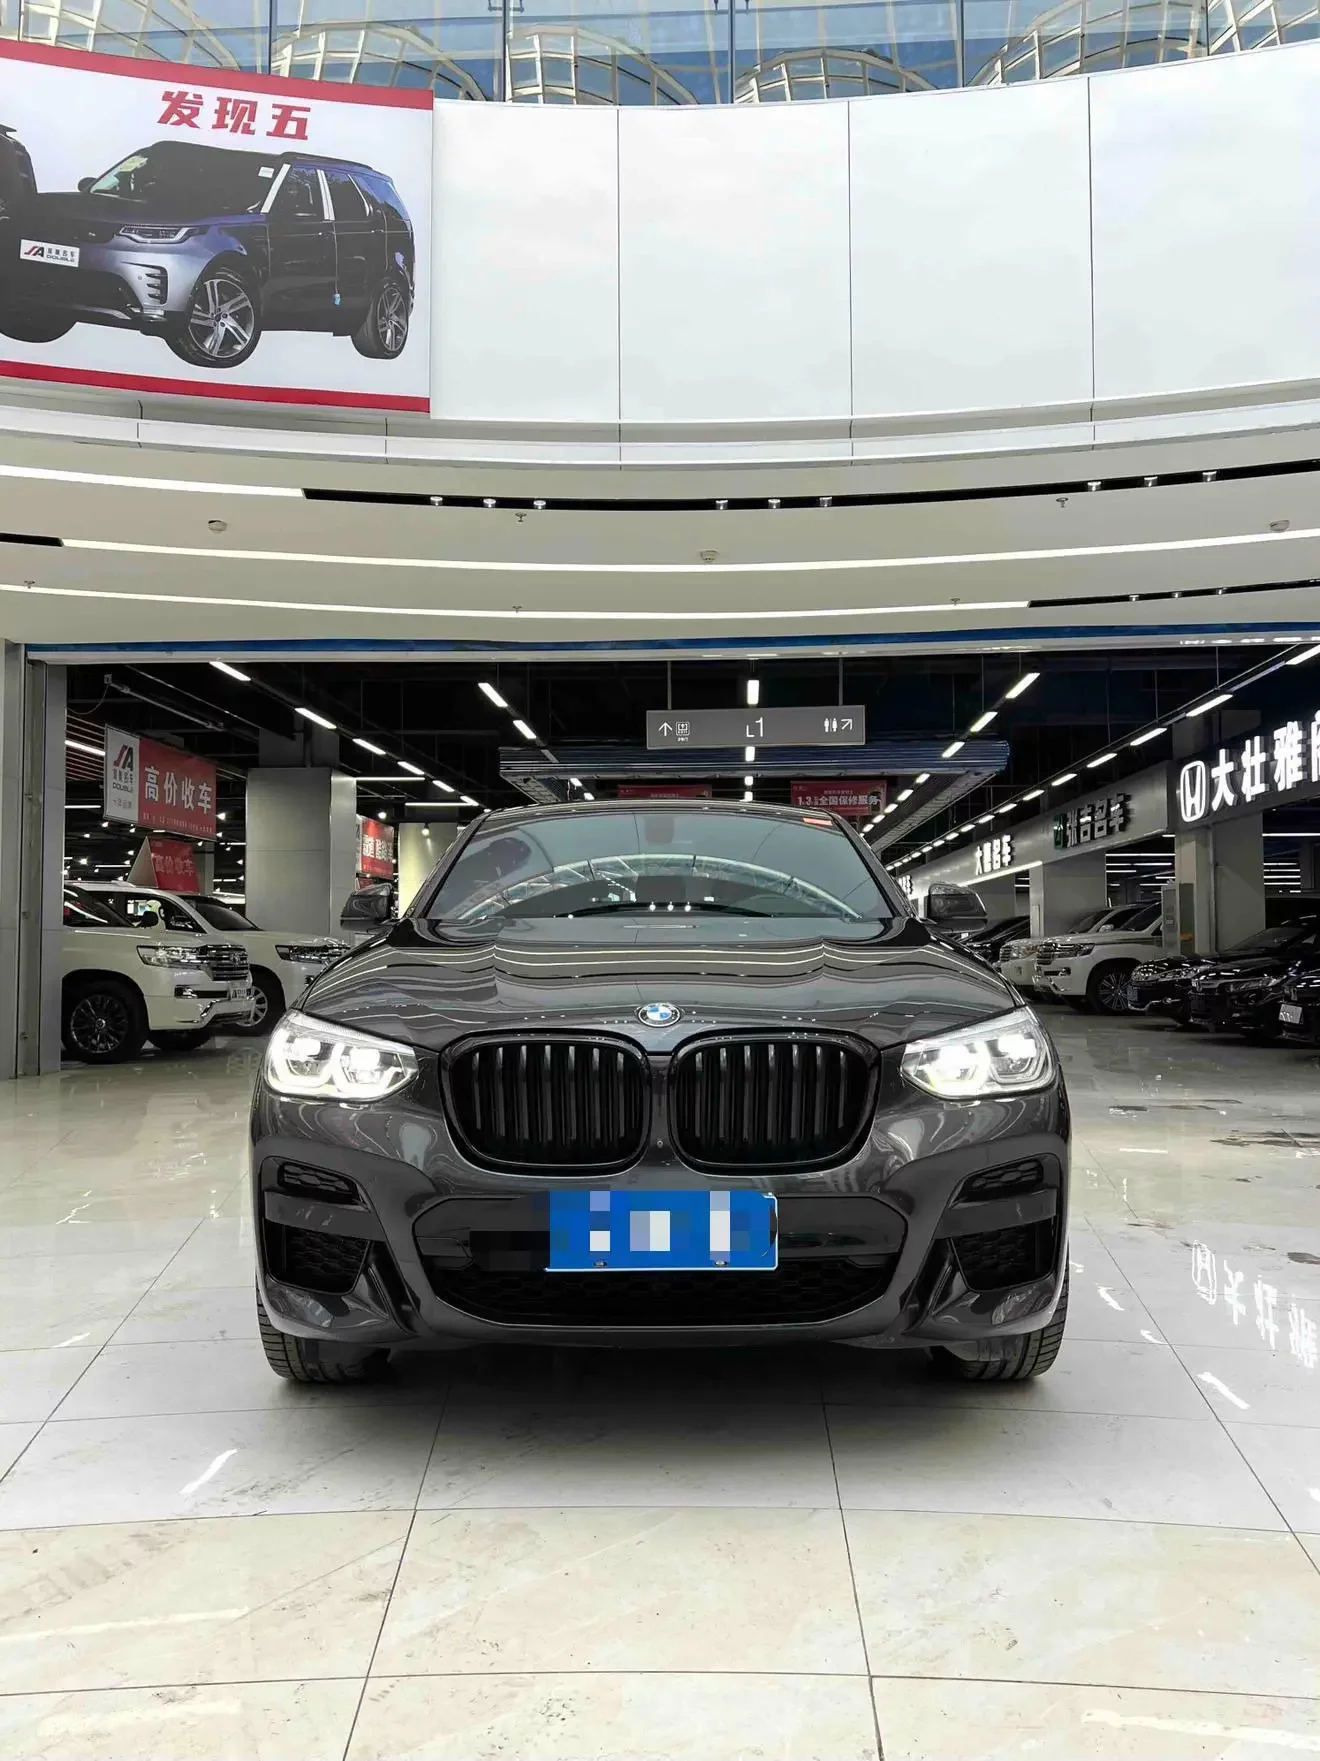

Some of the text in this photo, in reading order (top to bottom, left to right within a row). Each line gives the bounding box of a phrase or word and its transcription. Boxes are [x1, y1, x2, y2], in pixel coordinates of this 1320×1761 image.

[157, 90, 311, 141] 发现五
[746, 716, 764, 738] L1
[144, 766, 213, 814] 高价收车
